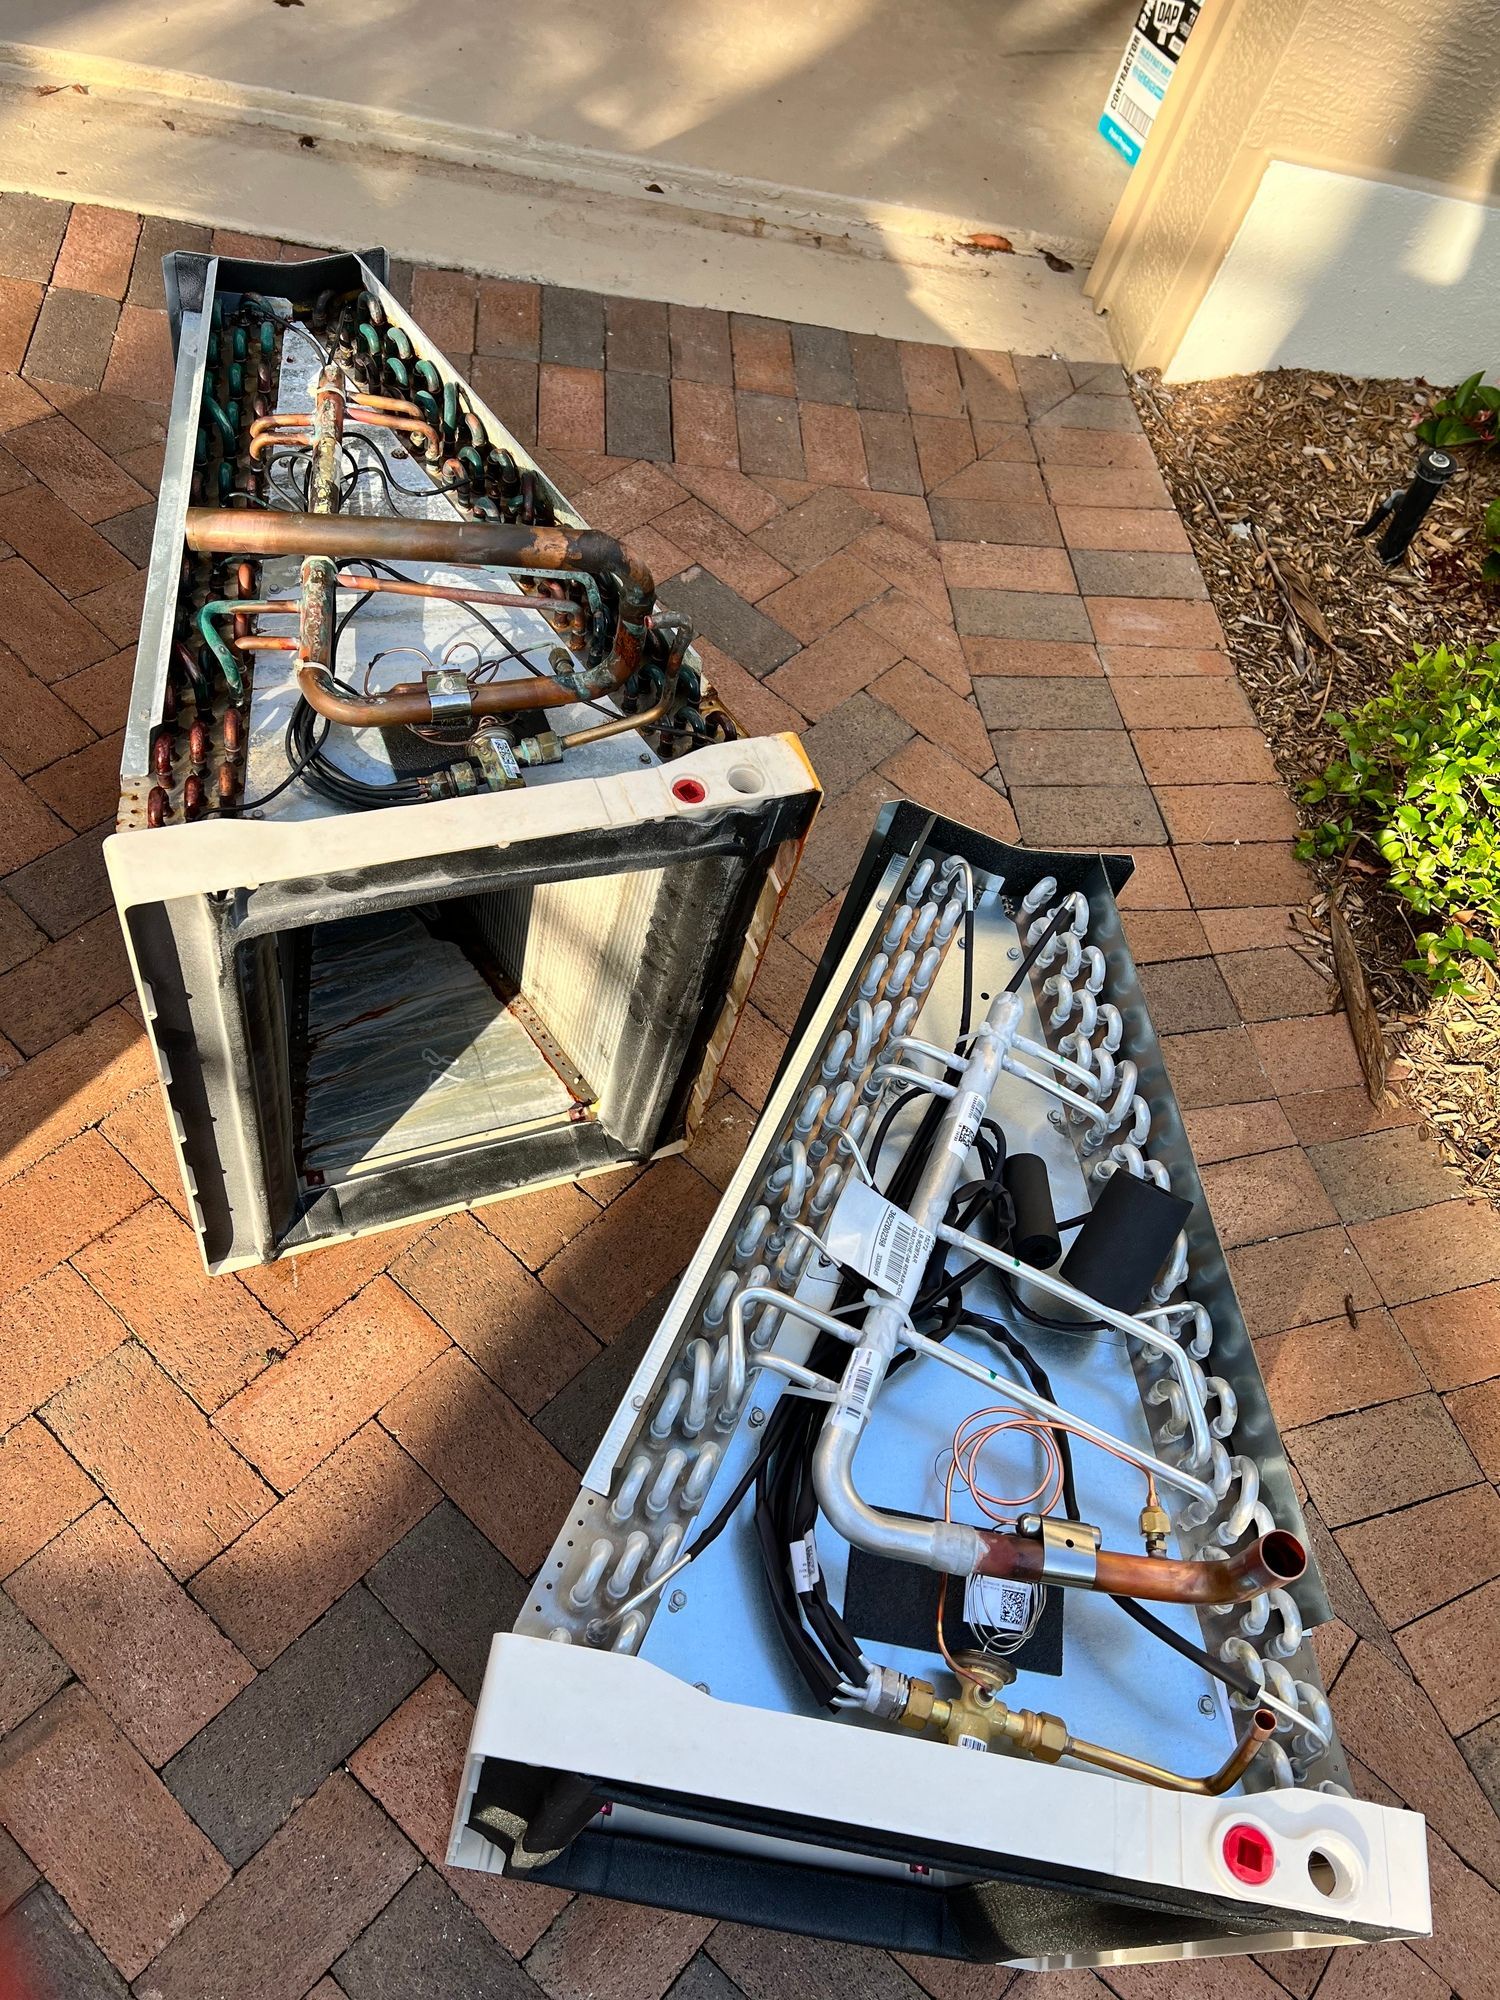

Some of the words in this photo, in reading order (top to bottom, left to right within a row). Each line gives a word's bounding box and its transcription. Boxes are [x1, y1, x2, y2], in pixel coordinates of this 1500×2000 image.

[1157, 2, 1180, 26] DAP
[1110, 34, 1141, 110] CONTRACTOR
[900, 1263, 909, 1284] REPAIR
[895, 1283, 904, 1297] COIL
